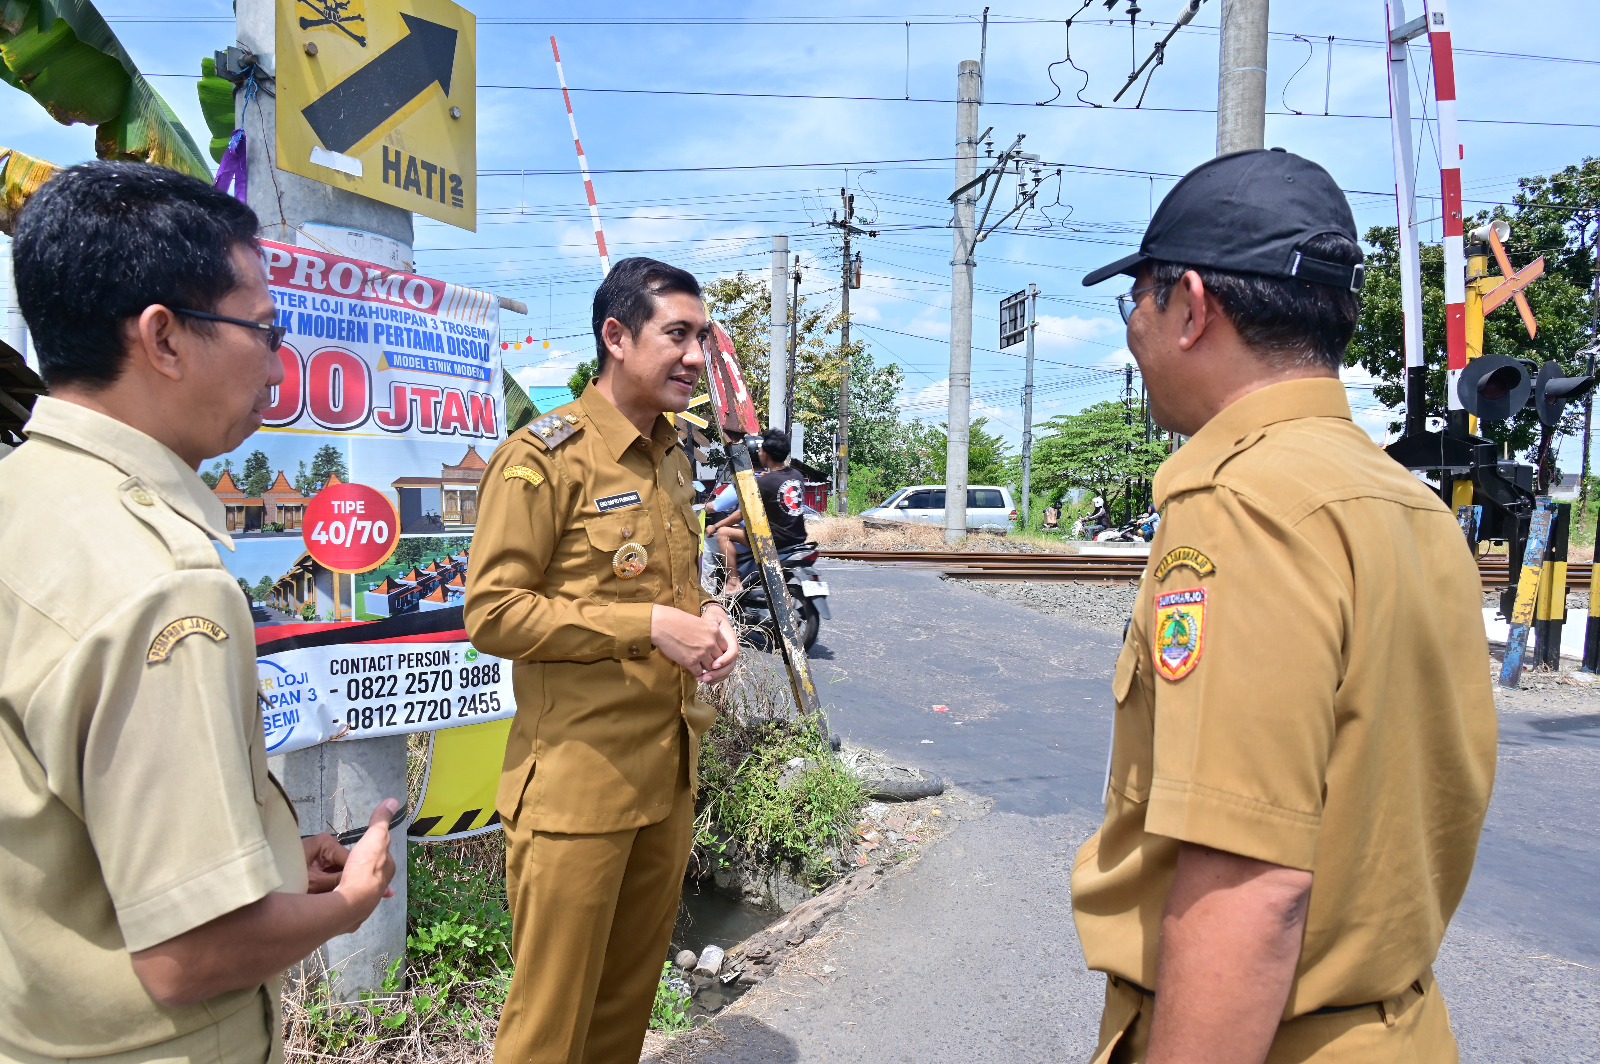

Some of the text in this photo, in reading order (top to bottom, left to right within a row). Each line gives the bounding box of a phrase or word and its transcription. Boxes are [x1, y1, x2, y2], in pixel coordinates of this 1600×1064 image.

[262, 246, 434, 309] PROMO
[297, 311, 369, 344] MODERN
[373, 322, 445, 354] PERTAMA
[446, 335, 490, 362] DISOLO
[312, 297, 344, 315] LOJI
[348, 302, 428, 328] KAHURIPAN
[430, 318, 438, 330] 3
[440, 320, 490, 341] TROSEMI
[393, 354, 485, 379] MODEL ETNIK MODERN
[374, 382, 497, 437] JTAN
[331, 500, 365, 514] TIPE
[311, 516, 389, 548] 40/70
[151, 618, 221, 658] PEMPROV JATENG
[276, 671, 309, 688] LOJI
[330, 654, 393, 676] CONTACT
[398, 650, 451, 670] PERSON
[307, 687, 318, 702] 3
[346, 674, 398, 701] 0822
[404, 669, 453, 695] 2570
[459, 662, 501, 689] 9888
[263, 708, 300, 731] SEMI
[346, 703, 397, 731] 0812
[403, 698, 451, 725] 2720
[457, 690, 501, 718] 2455
